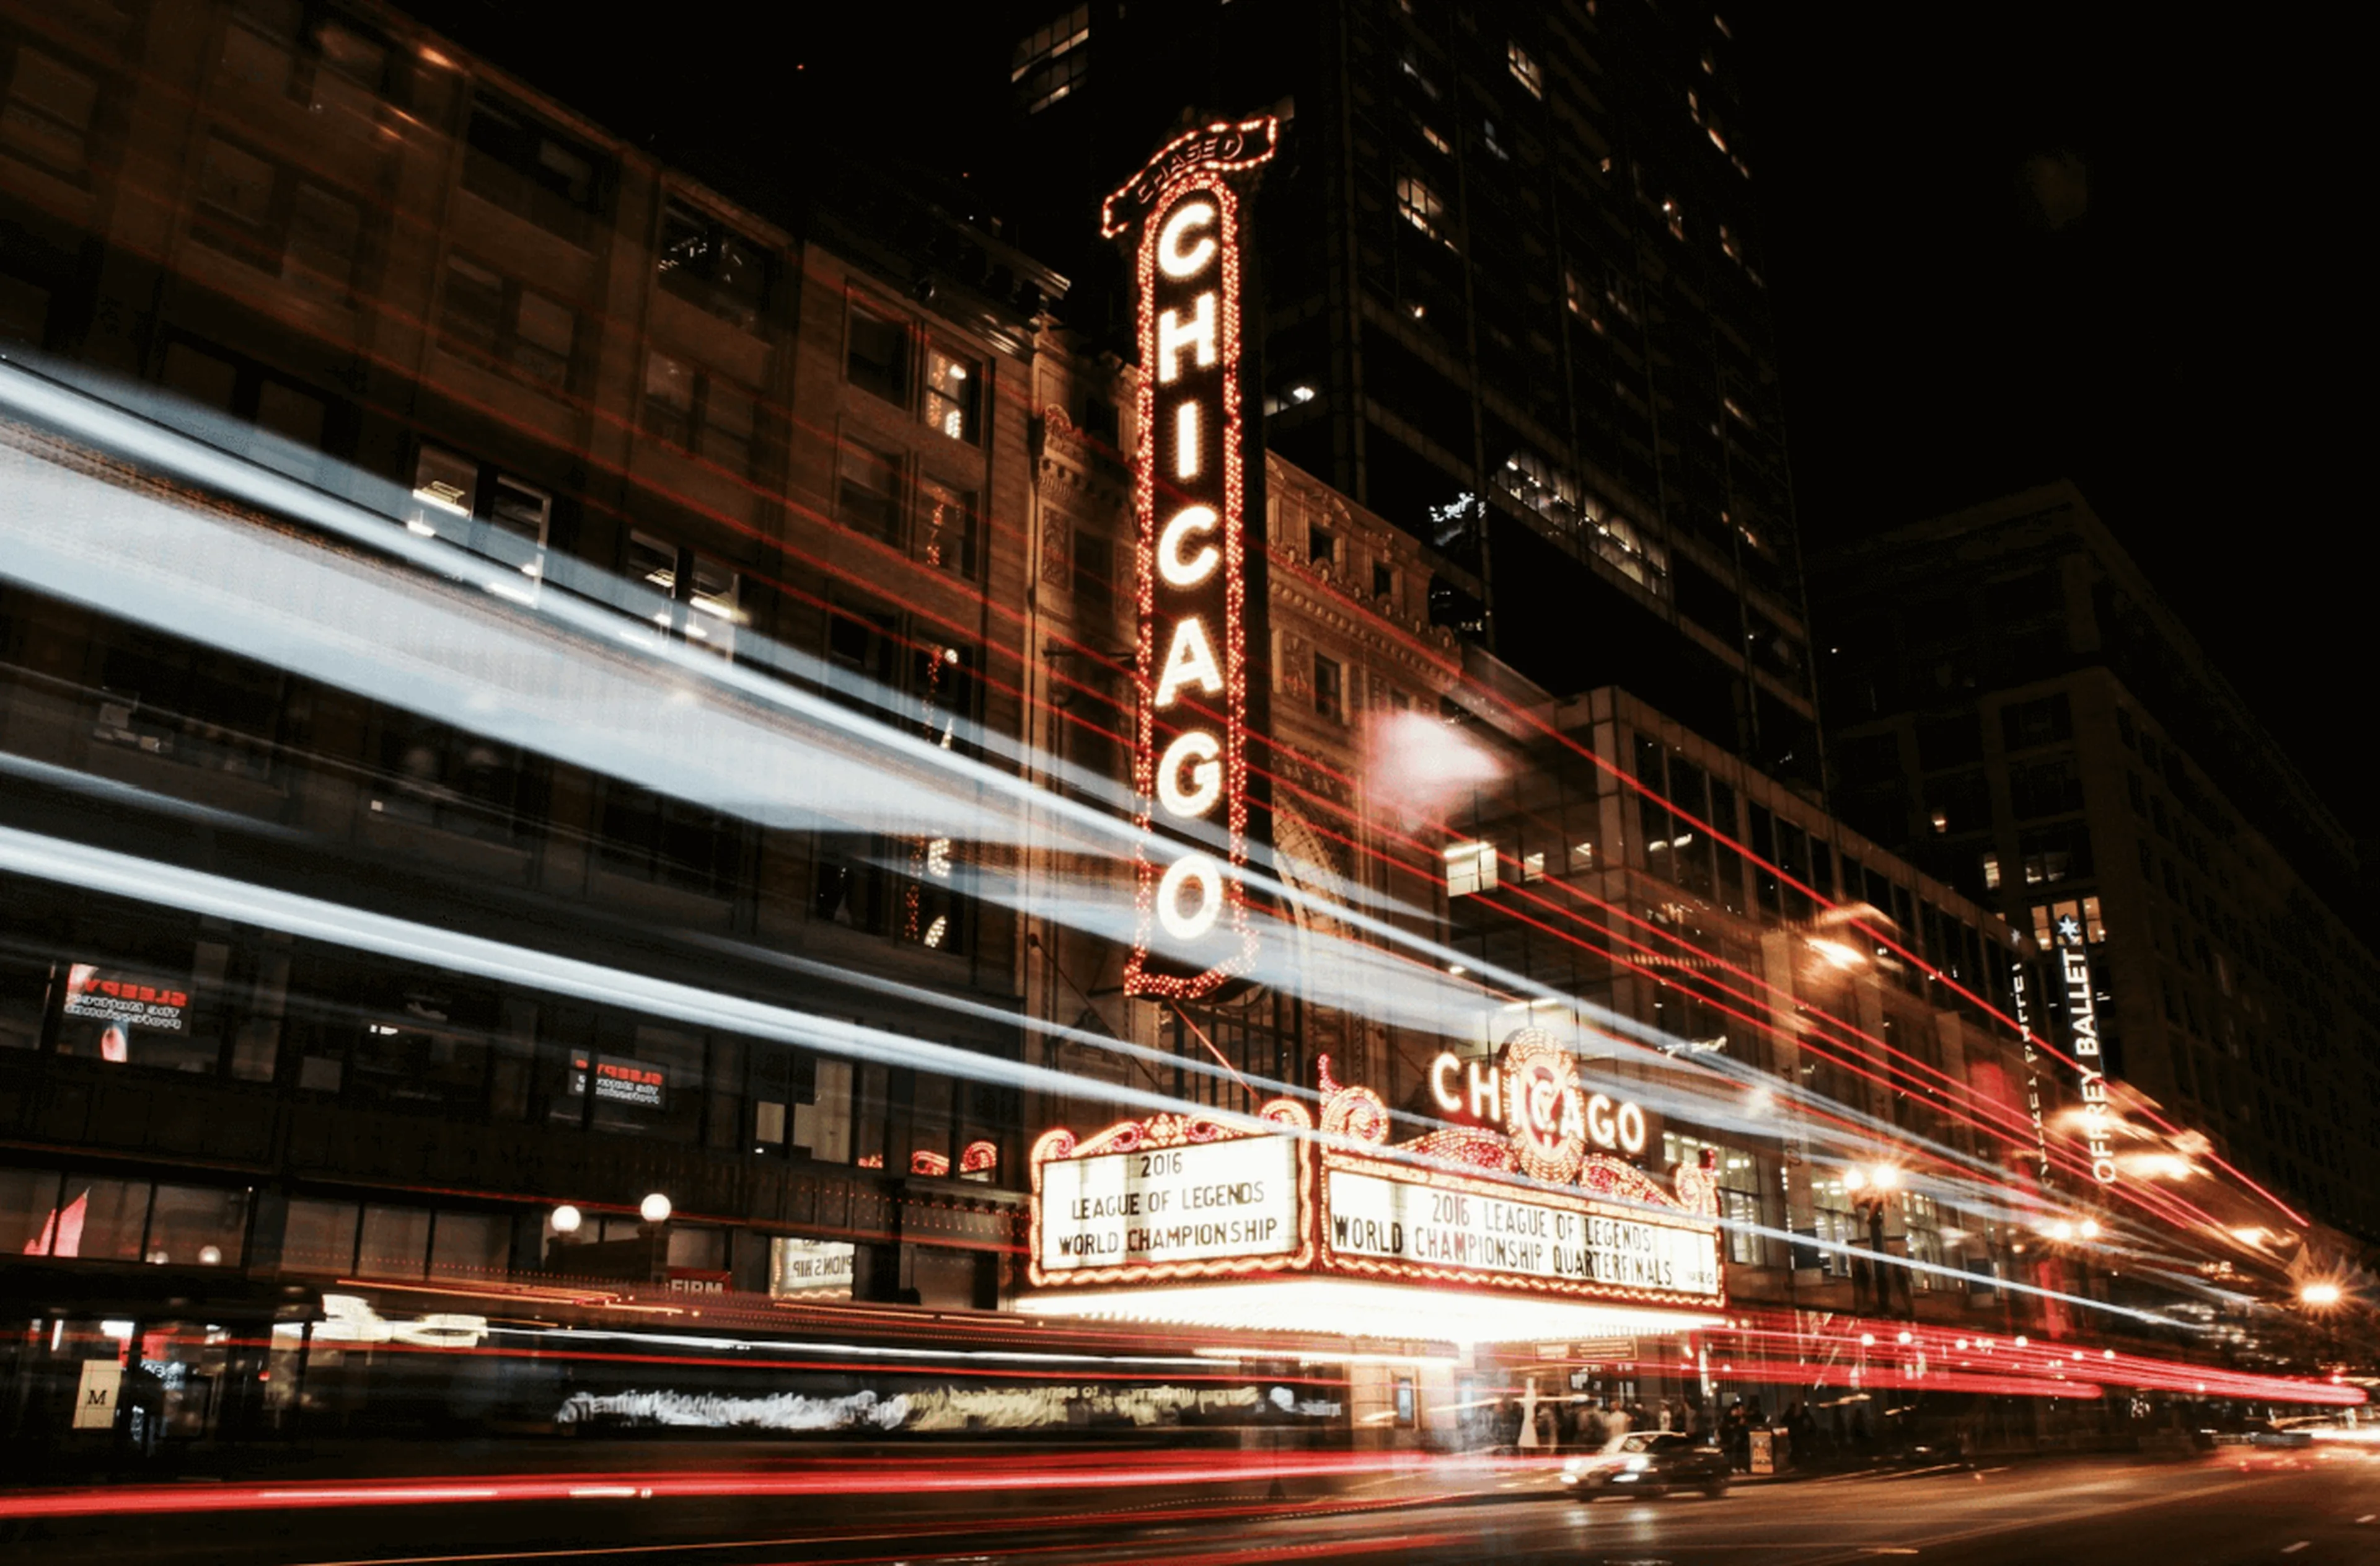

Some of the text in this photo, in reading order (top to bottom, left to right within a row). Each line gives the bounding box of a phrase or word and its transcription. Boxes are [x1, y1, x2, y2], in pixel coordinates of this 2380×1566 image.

[1155, 202, 1223, 940] CHICAGO
[2063, 948, 2099, 1055] BALLET
[1431, 1052, 1646, 1152] CHICAGO
[1140, 1151, 1183, 1178] 2016
[1072, 1180, 1264, 1219] LEAGUE OF LEGENDS
[1432, 1193, 1651, 1252] 2016 LEAGUE OF LEGENDS
[1059, 1217, 1277, 1256] WORLD CHAMPIONSHIP
[1333, 1214, 1673, 1286] WORLD CHAMPIONSHIP QUARTERFINALS
[87, 1389, 107, 1406] M
